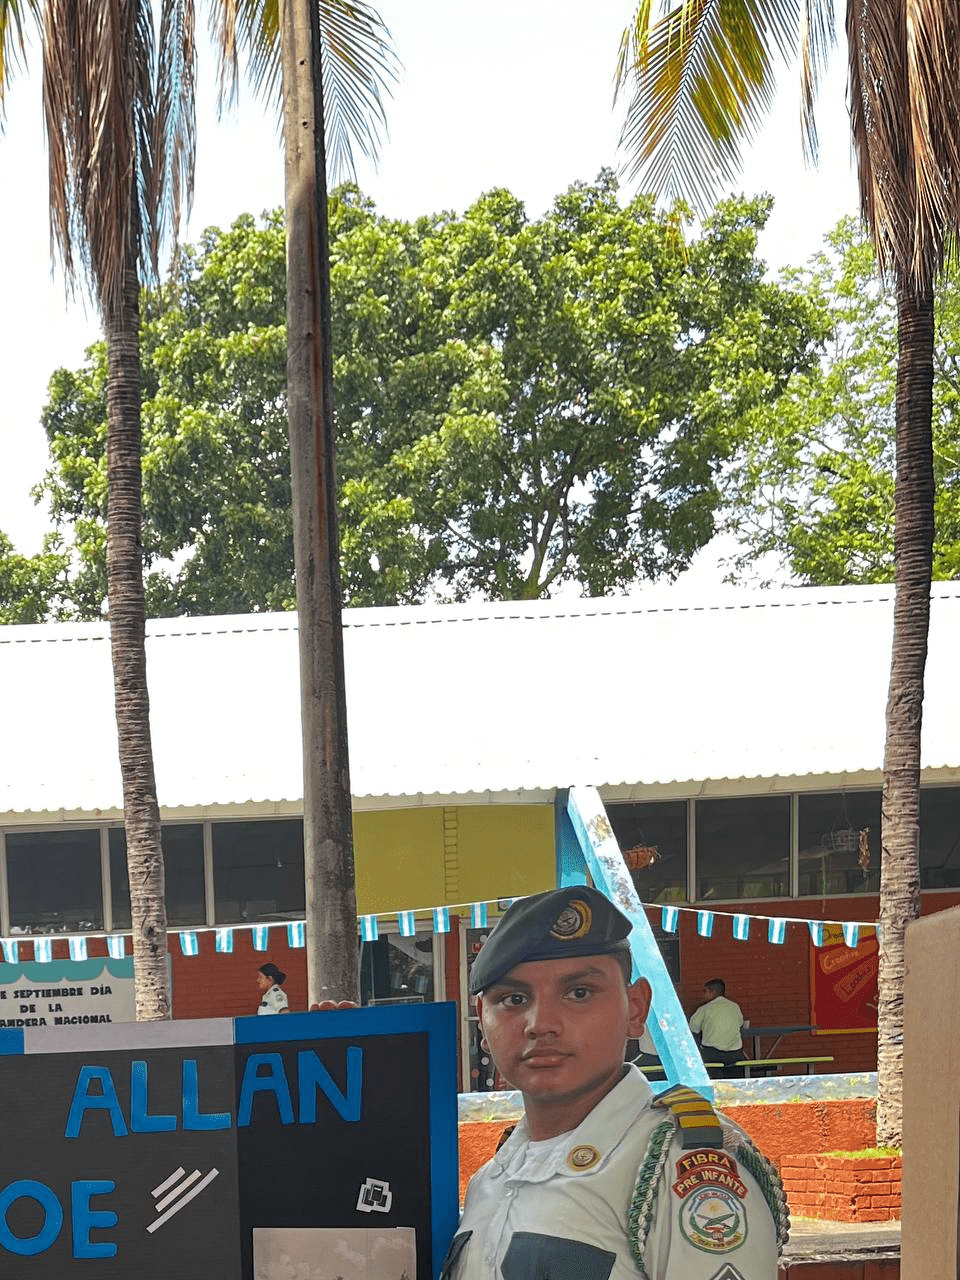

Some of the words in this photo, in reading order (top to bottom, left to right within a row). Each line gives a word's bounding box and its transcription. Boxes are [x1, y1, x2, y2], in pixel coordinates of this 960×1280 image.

[13, 987, 83, 999] SEPTIEMBRE
[90, 984, 112, 996] DÍA
[20, 1004, 36, 1013] DE
[48, 1003, 63, 1012] LA
[54, 1014, 112, 1025] NACIONAL
[64, 1046, 363, 1138] ALLAN
[682, 1153, 730, 1170] FIBRA
[676, 1175, 700, 1194] PRE
[701, 1170, 746, 1196] INFANTE
